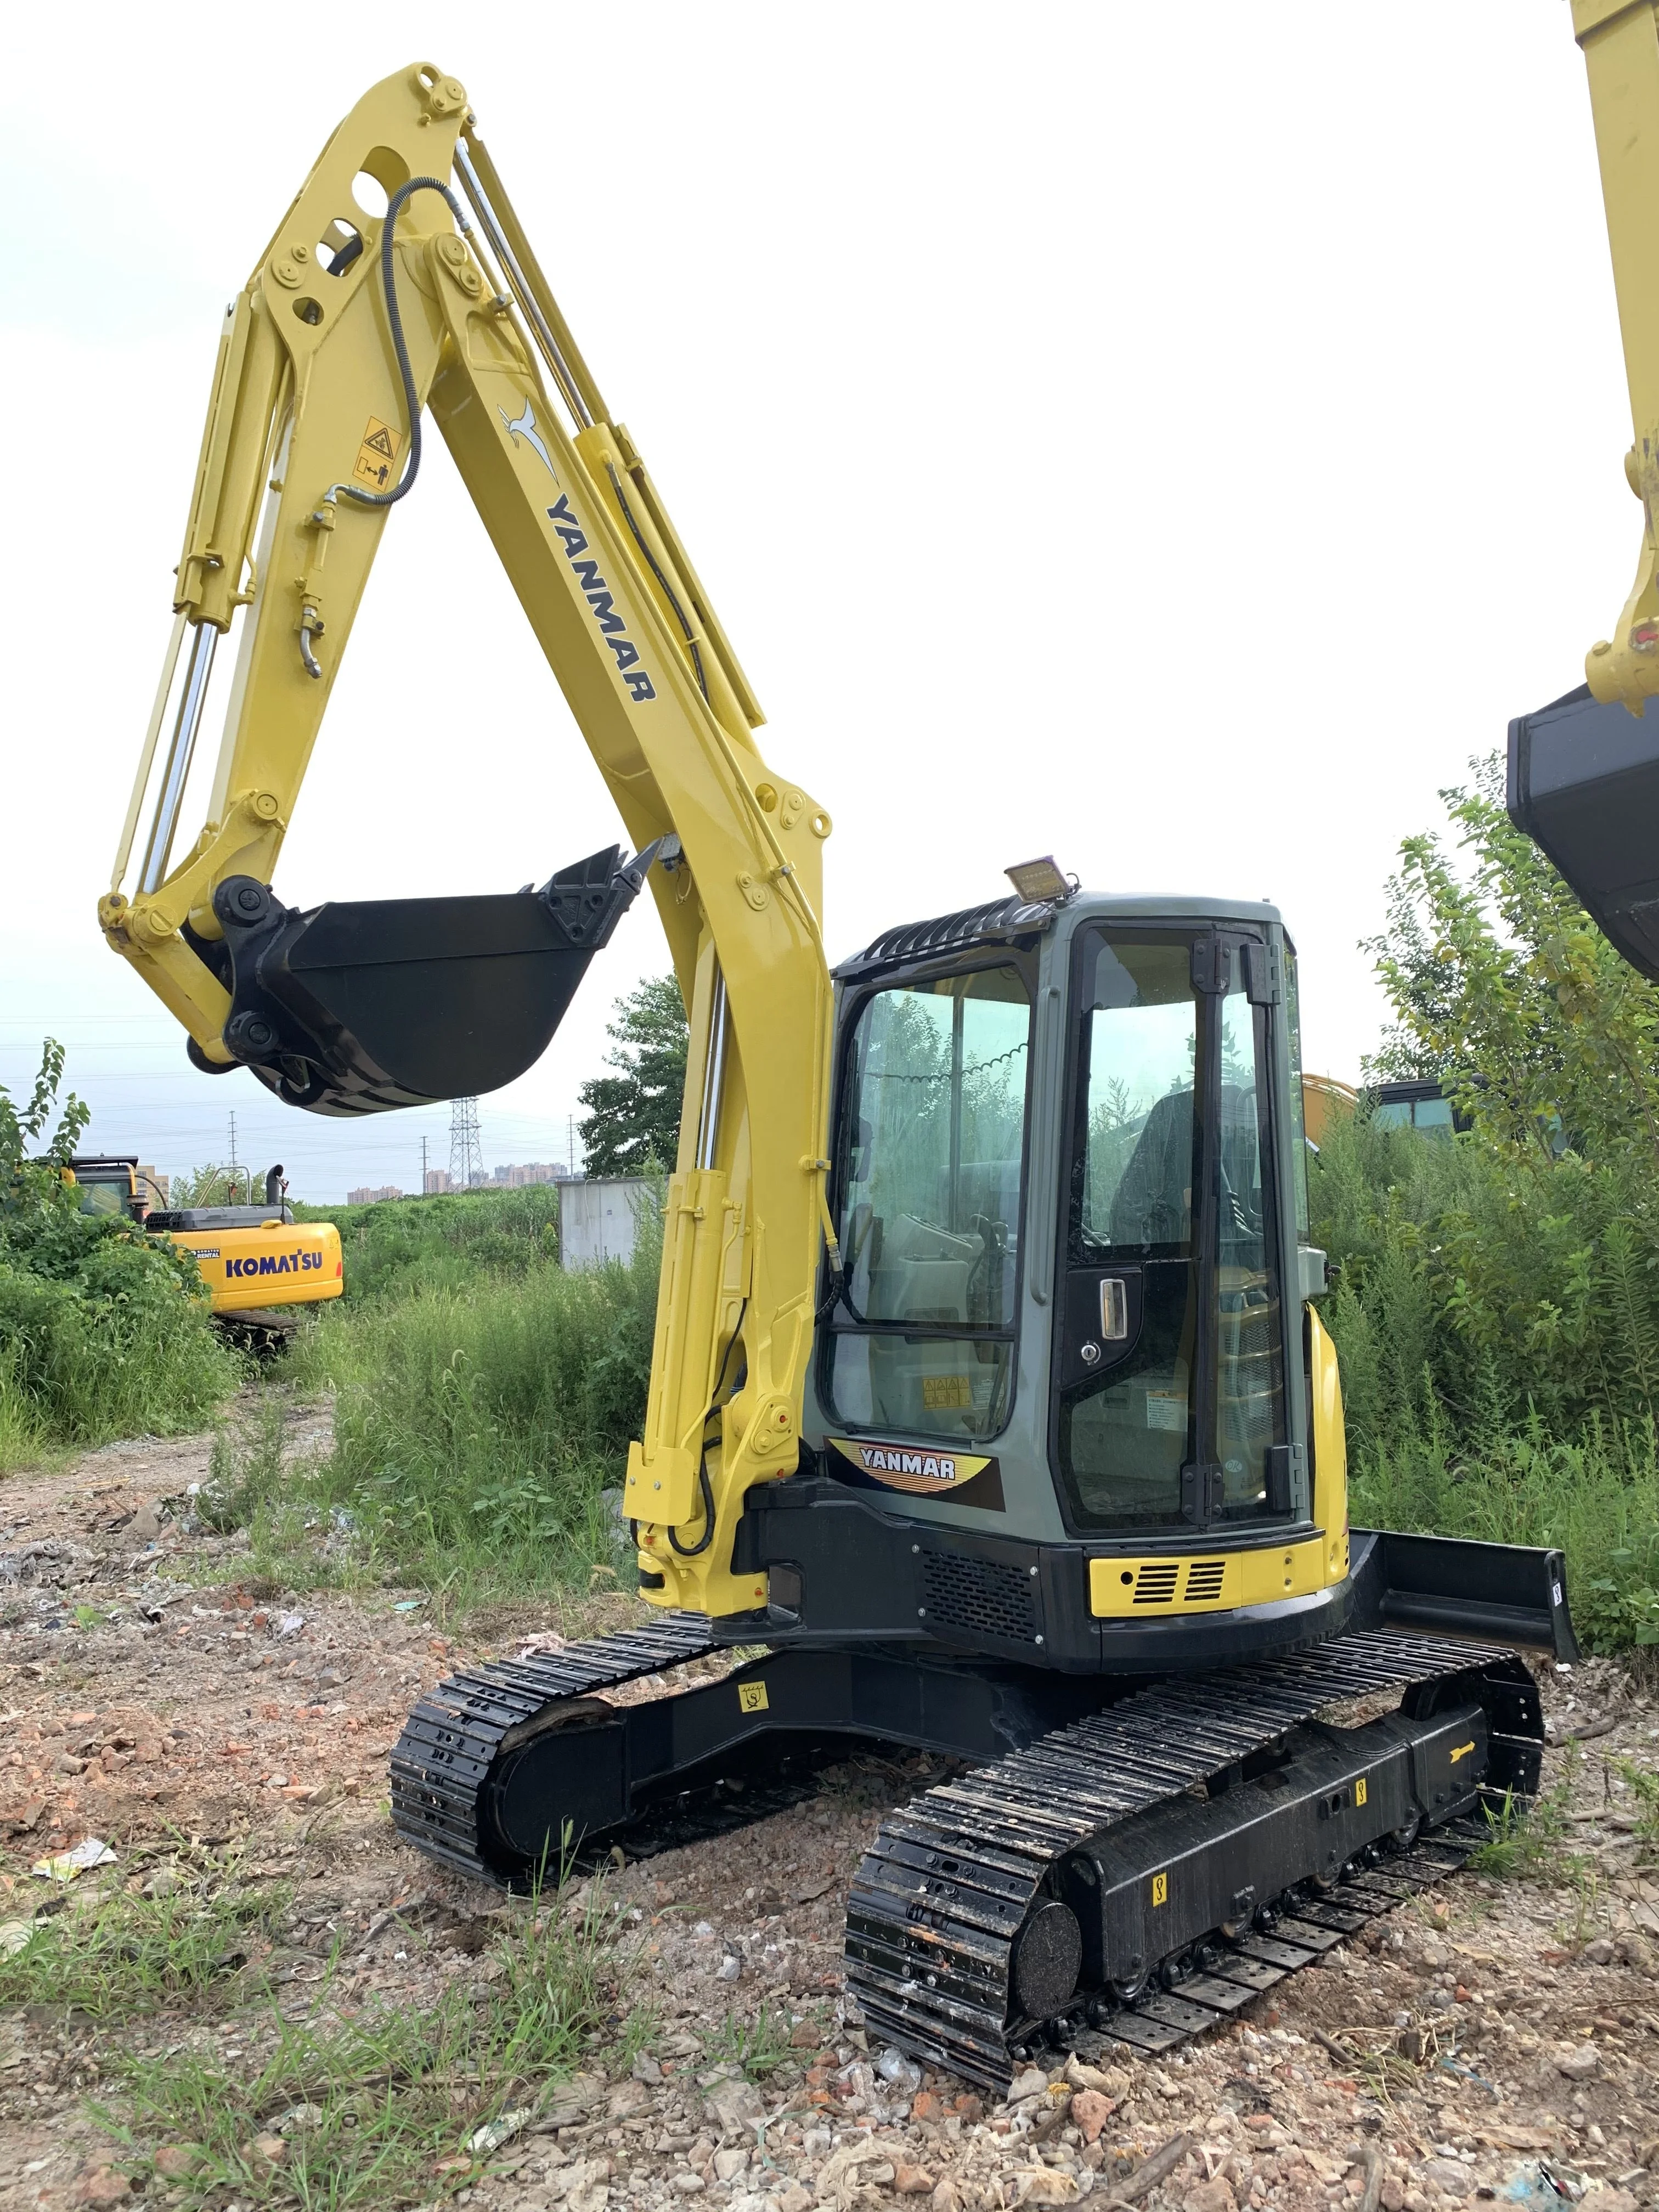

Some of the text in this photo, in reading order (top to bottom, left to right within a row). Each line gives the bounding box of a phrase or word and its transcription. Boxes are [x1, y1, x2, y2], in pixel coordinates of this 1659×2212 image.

[547, 492, 657, 703] YANMAR
[226, 1249, 323, 1278] KOMATSU
[859, 1448, 955, 1480] YANMAR
[1227, 1461, 1239, 1471] OK
